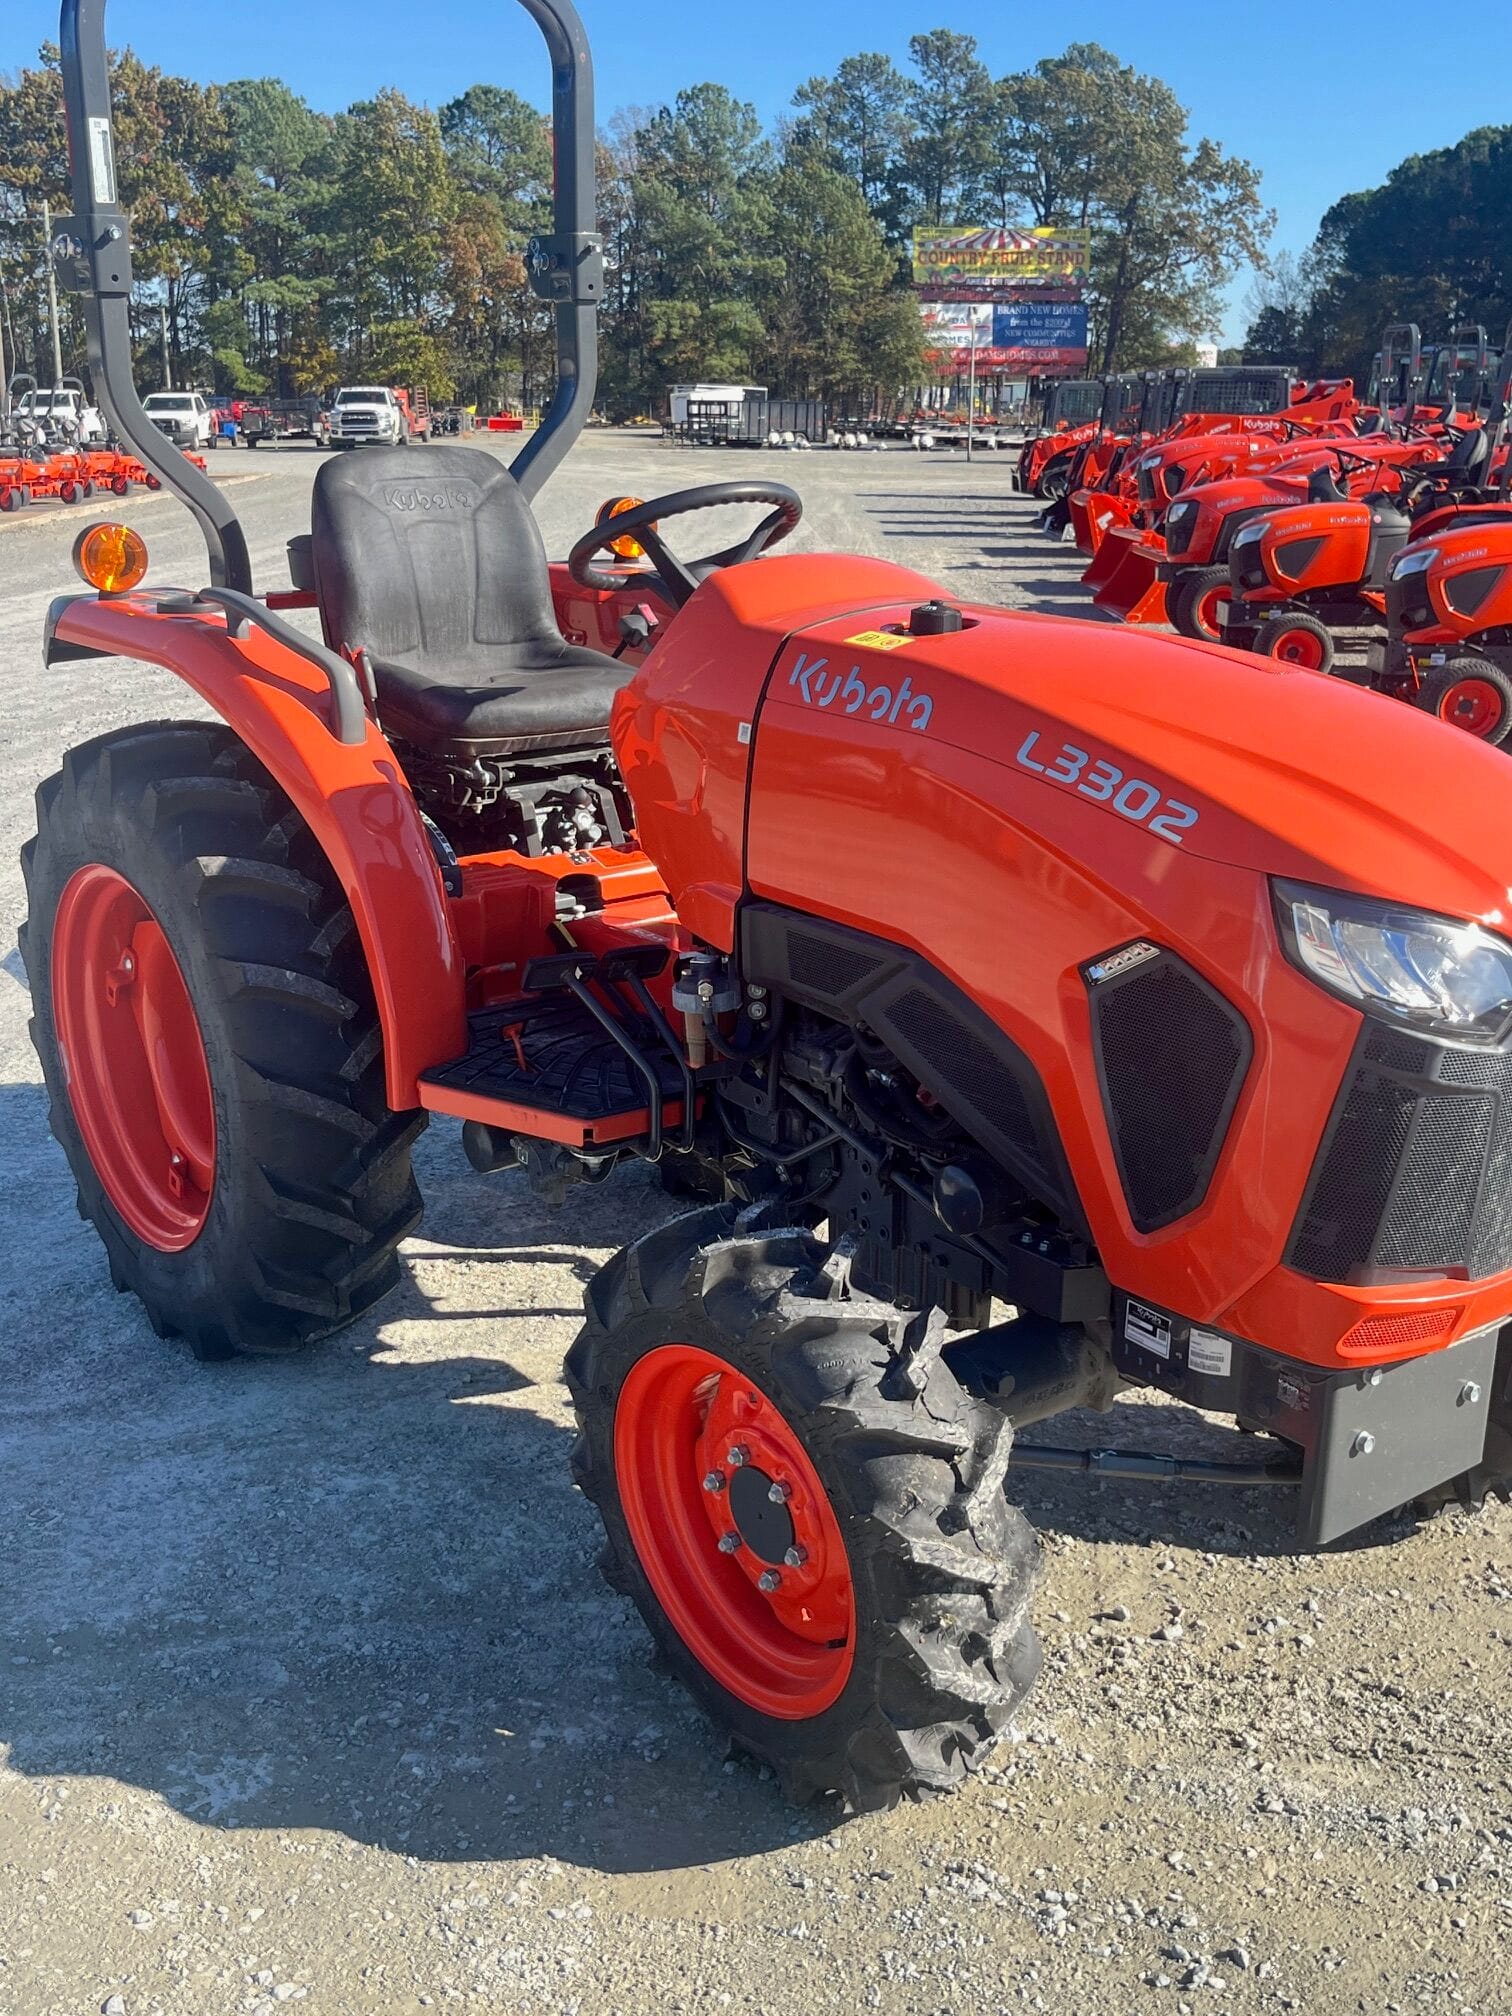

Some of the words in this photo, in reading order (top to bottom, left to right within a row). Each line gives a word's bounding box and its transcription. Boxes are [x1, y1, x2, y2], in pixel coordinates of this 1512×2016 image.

[917, 251, 988, 266] COUNTRY
[991, 251, 1032, 265] FRUIT
[1037, 251, 1085, 265] STAND
[997, 305, 1029, 315] BRAND
[1030, 305, 1051, 315] NEW
[1053, 305, 1085, 315] HOMES
[1010, 317, 1028, 327] from
[1030, 317, 1042, 327] the
[1004, 329, 1022, 337] NEW
[1243, 419, 1280, 431] Kubota
[383, 487, 472, 511] Kubota
[788, 653, 935, 732] Kubota
[1016, 731, 1200, 844] L3302
